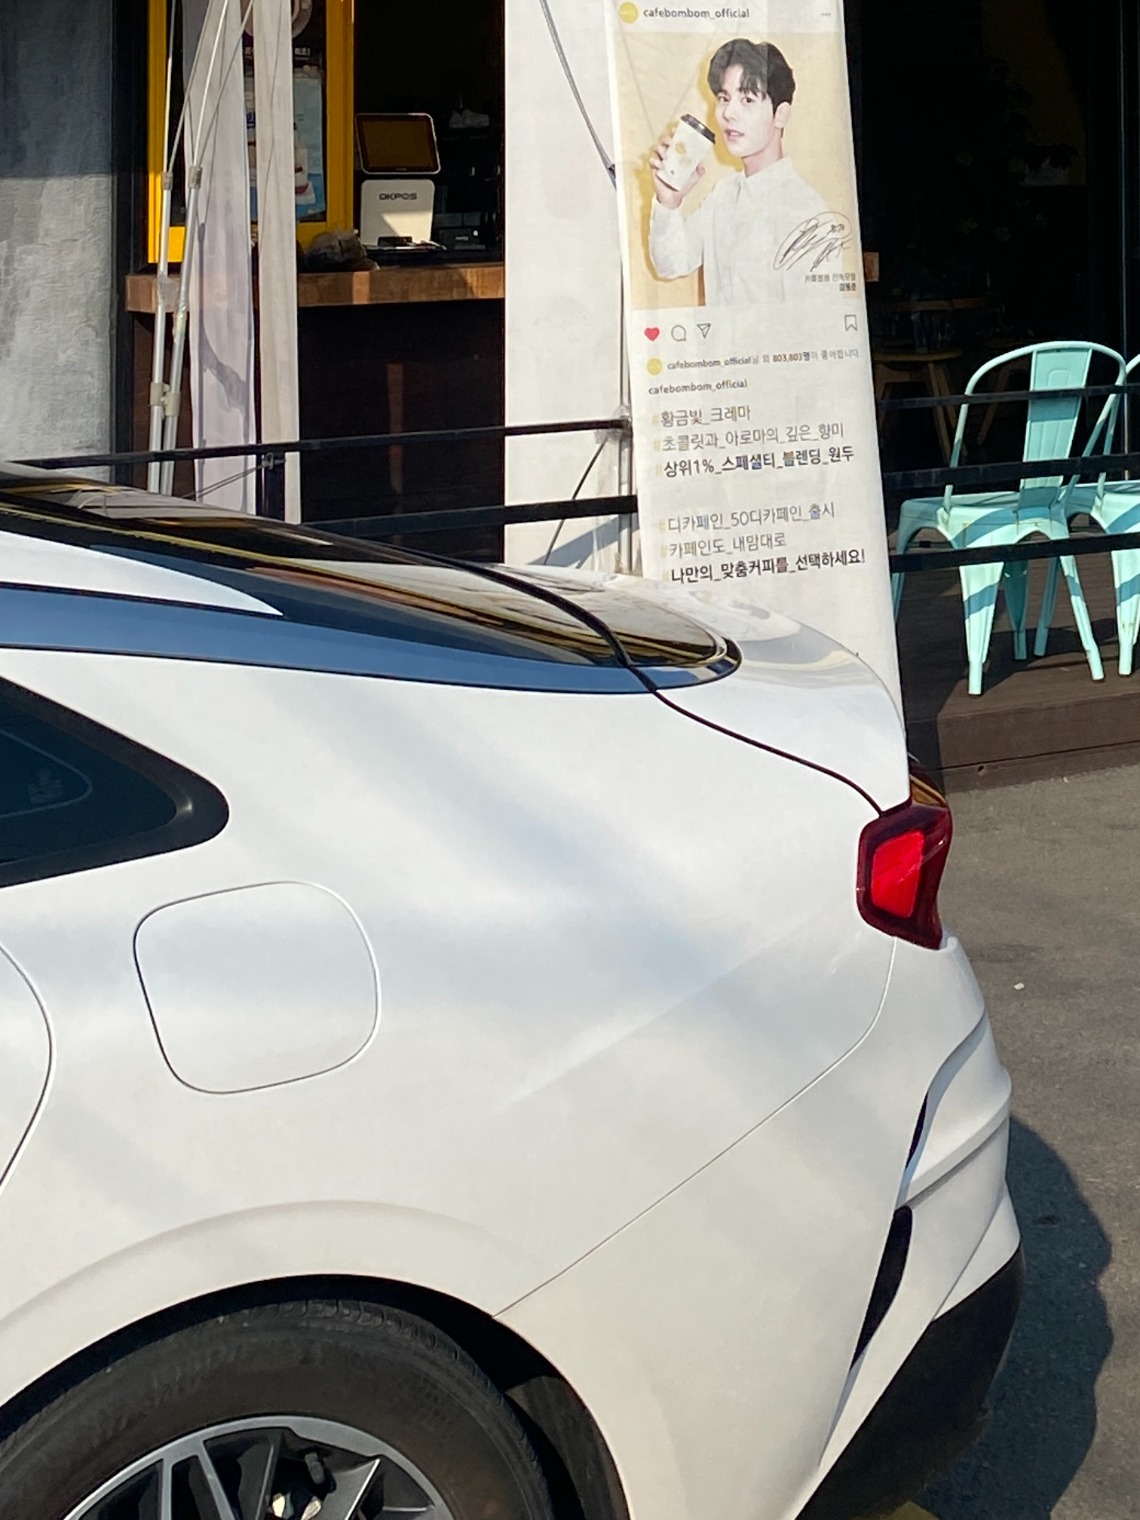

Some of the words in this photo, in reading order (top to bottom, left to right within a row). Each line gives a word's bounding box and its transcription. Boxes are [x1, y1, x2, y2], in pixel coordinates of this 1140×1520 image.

[642, 7, 750, 20] cafebombom_official
[378, 192, 418, 201] OKPOS
[648, 378, 749, 396] cafebombom_official
